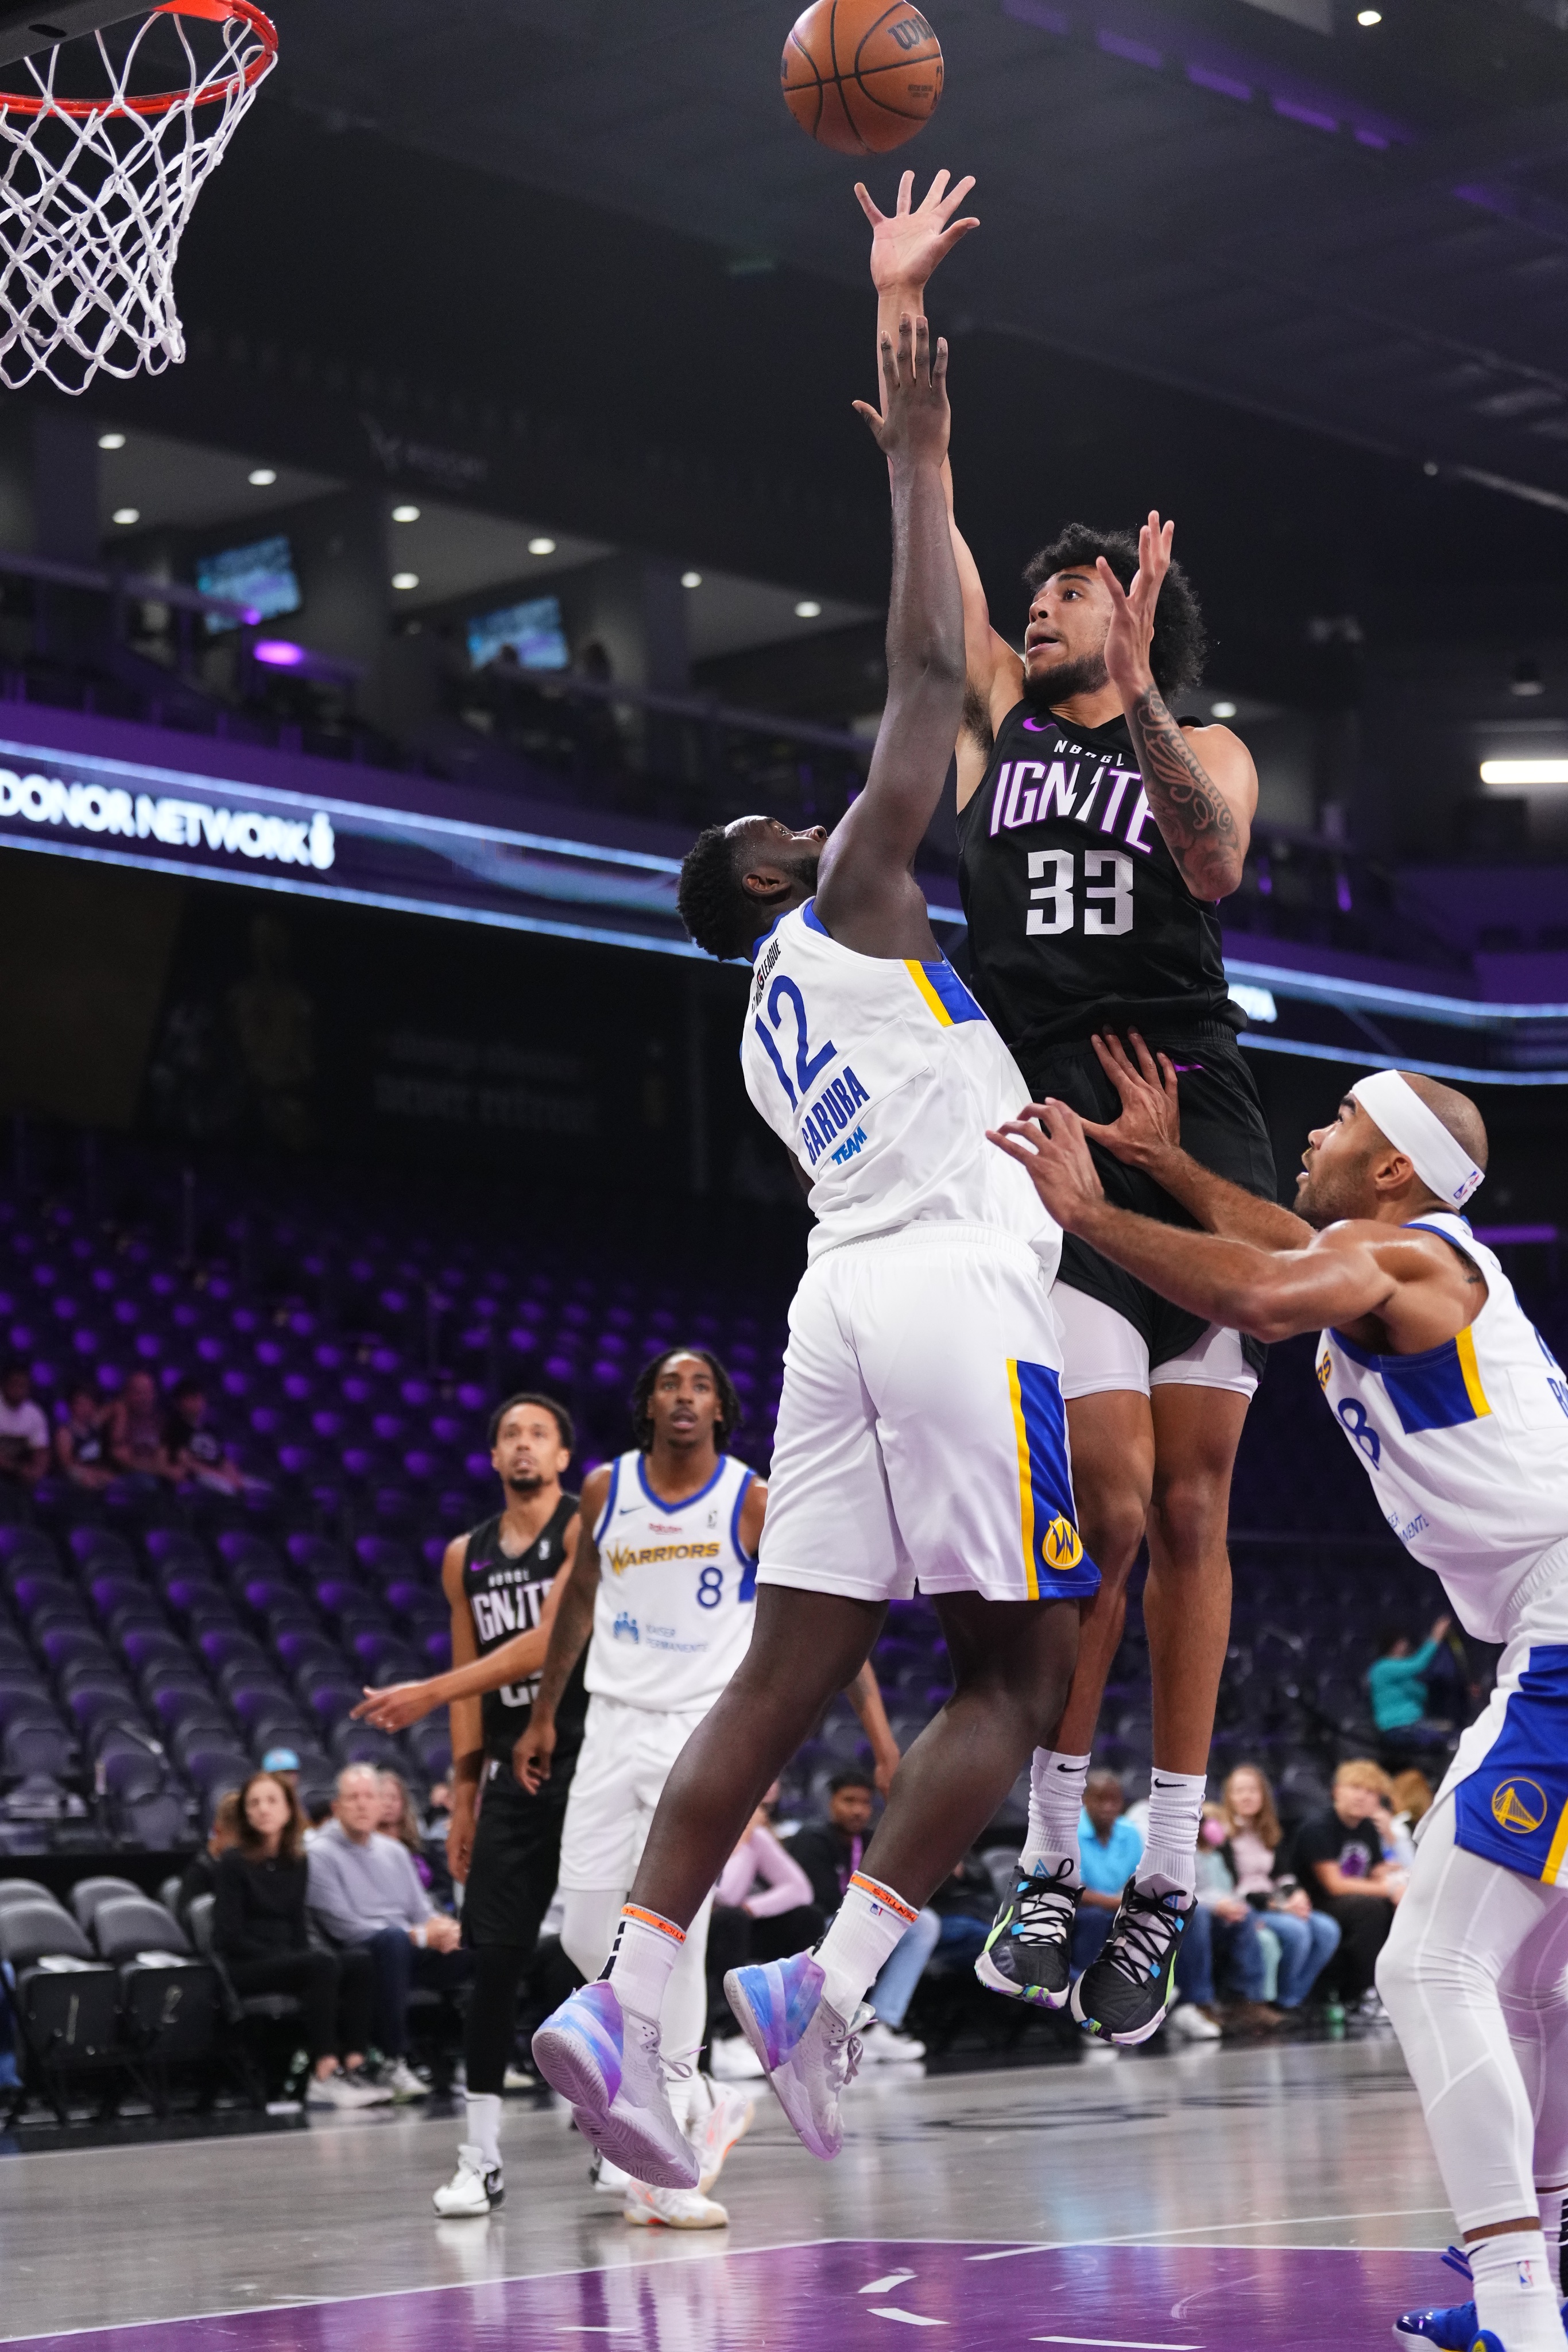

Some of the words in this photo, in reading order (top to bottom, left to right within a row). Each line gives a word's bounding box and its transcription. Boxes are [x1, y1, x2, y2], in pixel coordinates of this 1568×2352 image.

[0, 768, 135, 837] DONOR
[135, 795, 311, 866] NETWORK
[990, 761, 1156, 855] IGNITE
[1026, 849, 1133, 935] 33
[761, 938, 781, 981] LEAGUE
[755, 975, 838, 1113] 12
[802, 1066, 870, 1166] GARUBA
[831, 1126, 868, 1166] TEAM
[696, 1566, 723, 1610] 8
